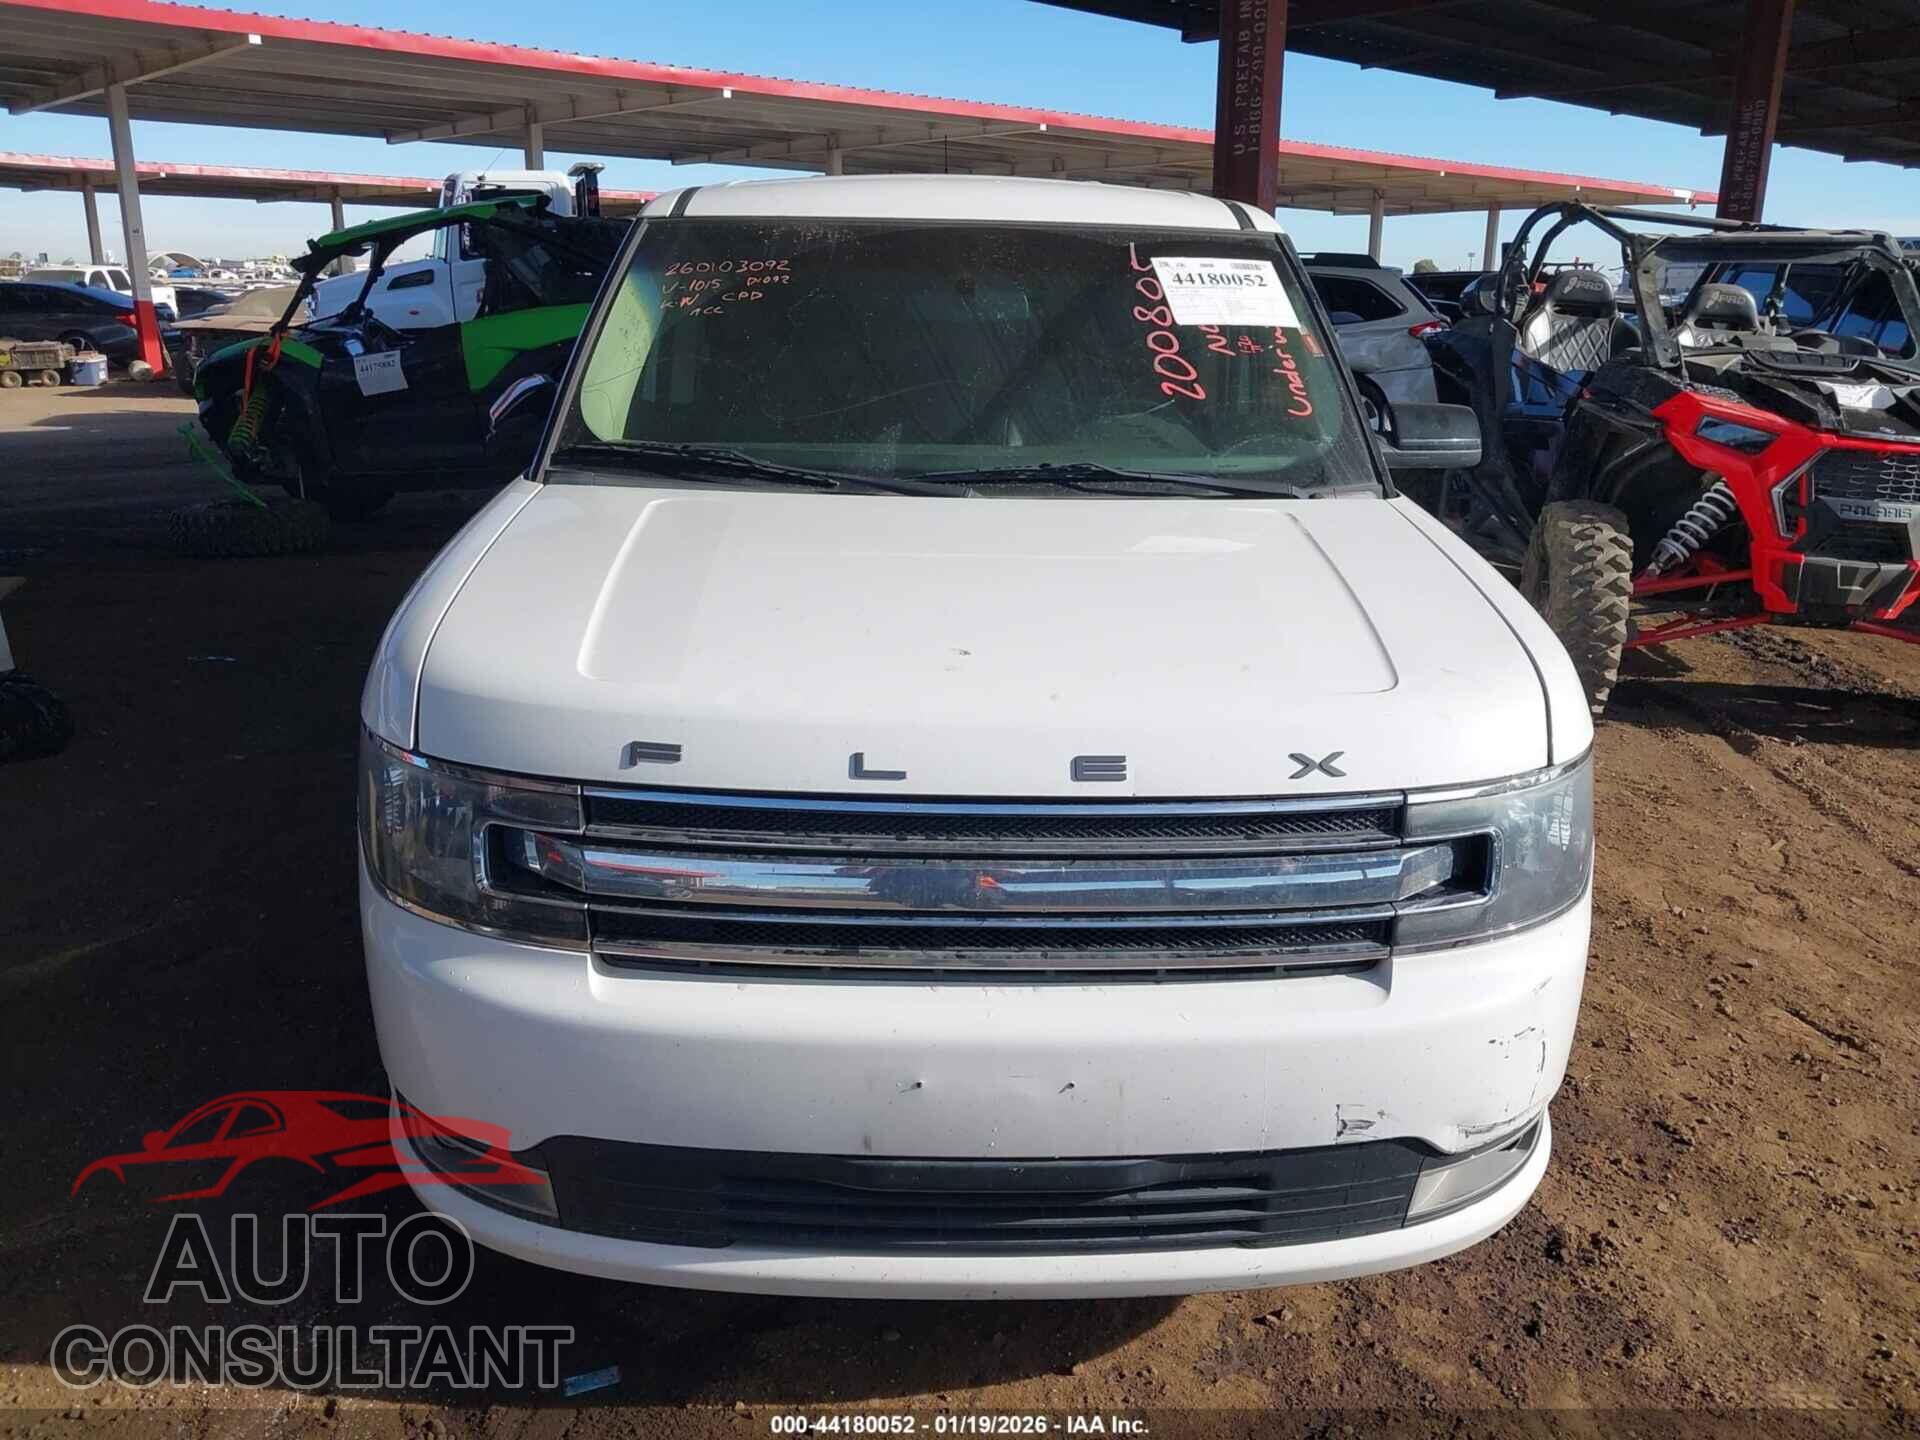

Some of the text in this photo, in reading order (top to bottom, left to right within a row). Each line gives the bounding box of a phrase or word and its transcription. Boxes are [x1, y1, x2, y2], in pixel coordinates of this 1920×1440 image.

[1234, 30, 1251, 107] PREFAB
[664, 259, 792, 277] 260103092
[1172, 271, 1269, 288] 44180052
[721, 290, 764, 302] CPD
[1839, 502, 1913, 520] POLARIS
[618, 740, 1347, 782] FLEX
